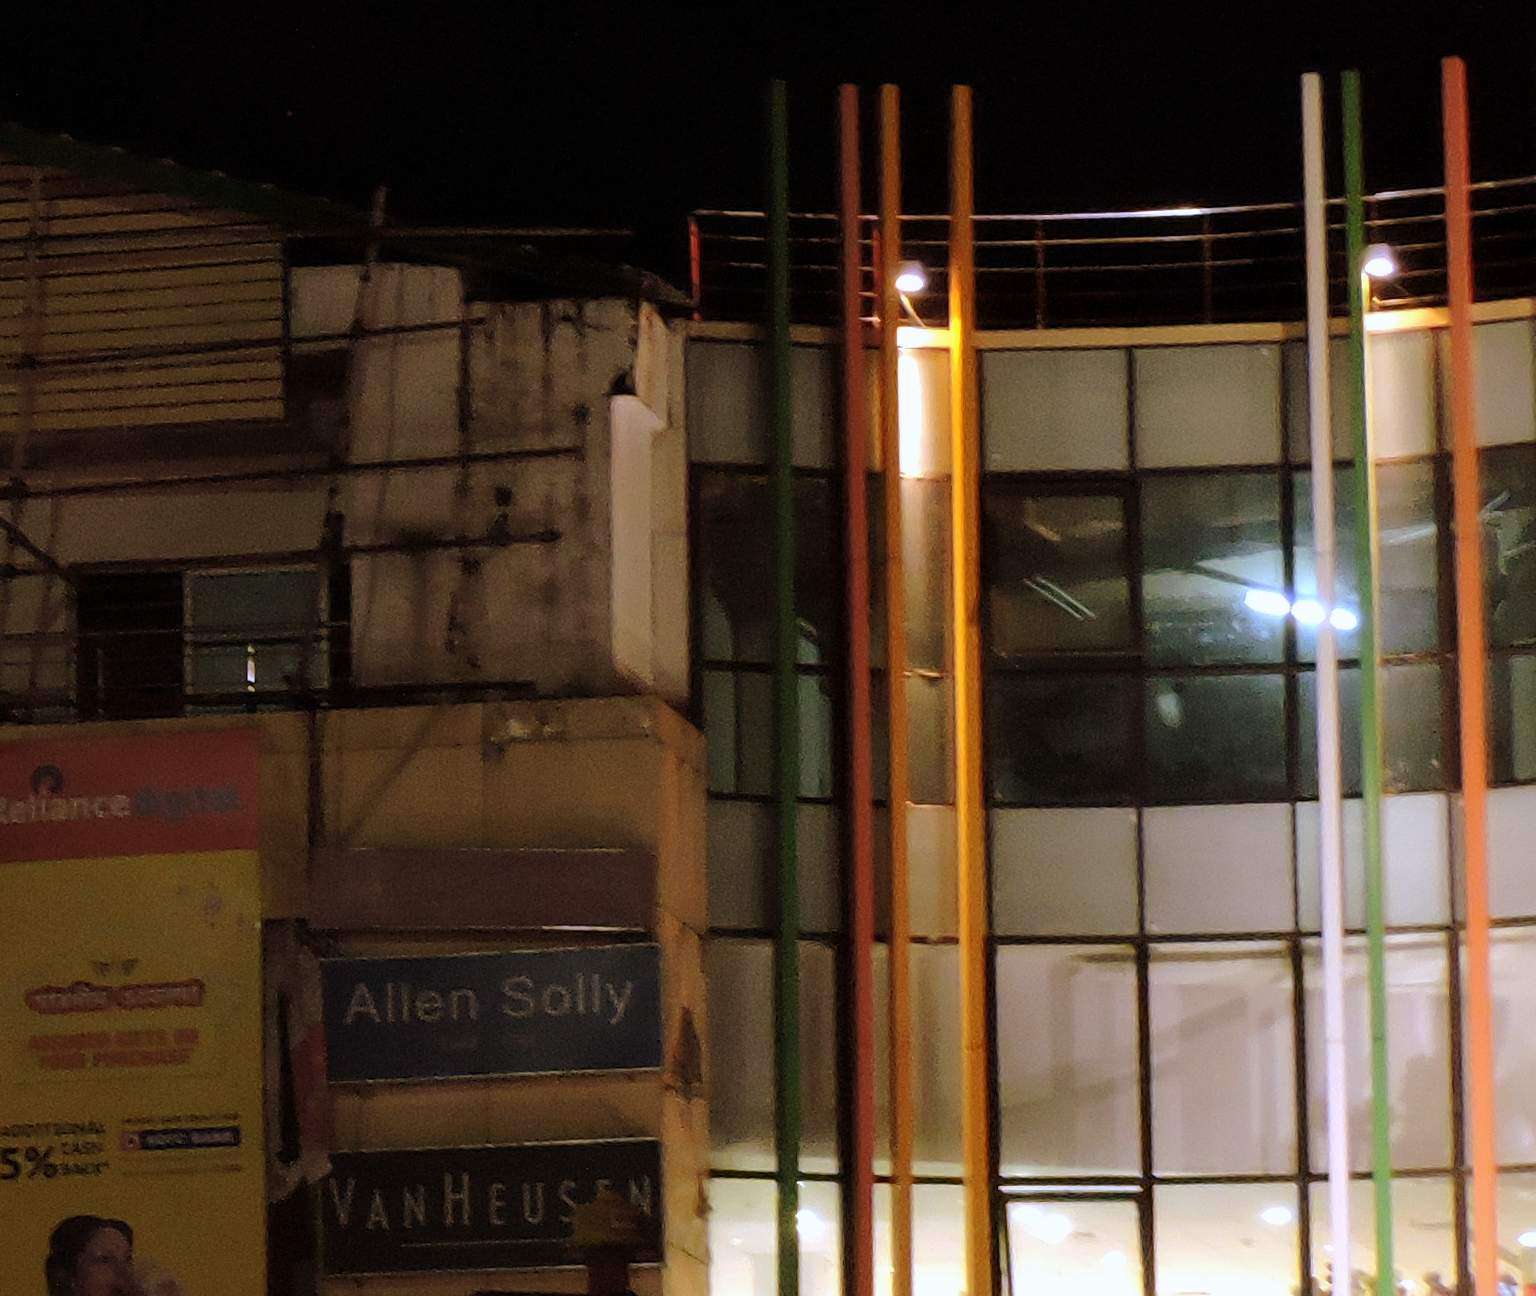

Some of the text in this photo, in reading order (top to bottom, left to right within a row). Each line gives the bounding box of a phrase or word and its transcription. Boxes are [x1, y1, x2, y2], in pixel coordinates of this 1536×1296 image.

[343, 973, 632, 1025] Allen Solly
[0, 1146, 58, 1181] 5%
[327, 1168, 654, 1233] VANHEUSN
